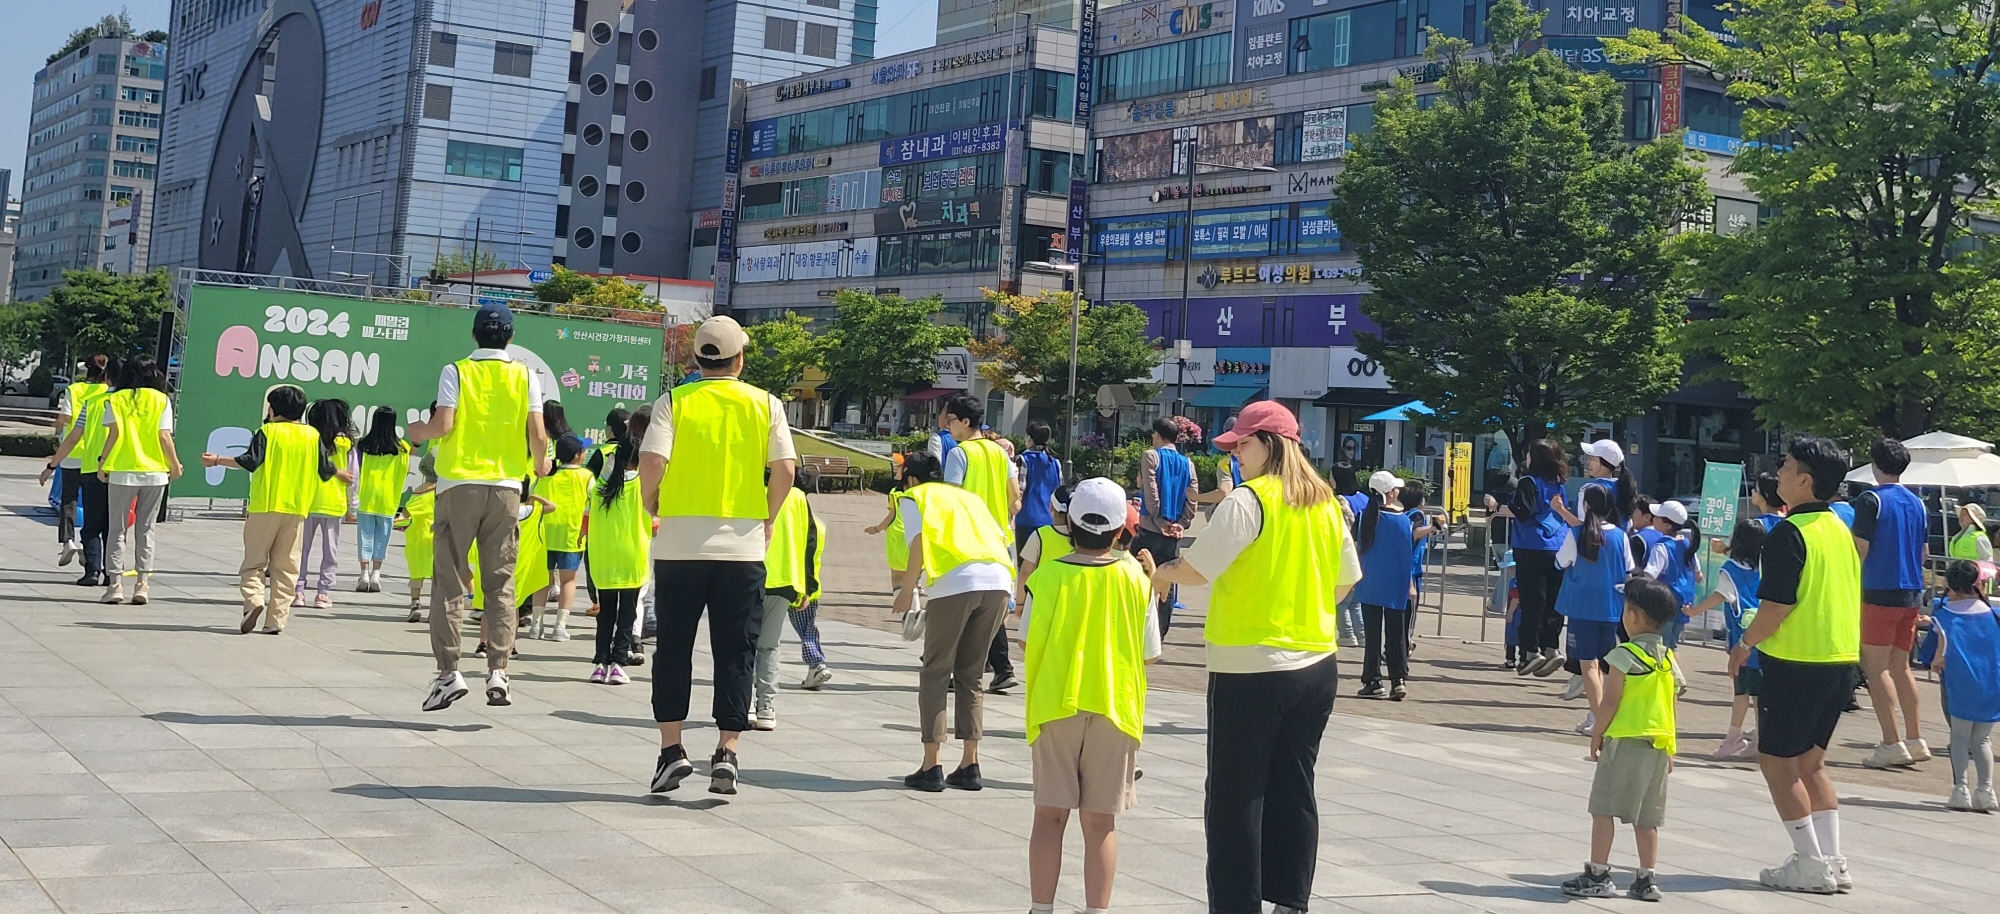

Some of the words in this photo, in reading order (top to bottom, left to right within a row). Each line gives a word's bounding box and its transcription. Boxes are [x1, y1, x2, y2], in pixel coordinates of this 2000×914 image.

[1169, 3, 1212, 35] CMS
[1567, 6, 1635, 23] 치아교정
[1248, 32, 1283, 50] 임플란트
[1246, 52, 1283, 69] 치아교정
[181, 63, 208, 105] NC
[1663, 93, 1678, 123] 마사지
[953, 124, 1002, 145] 이비인후과
[900, 135, 946, 161] 참내과
[963, 140, 1001, 154] 487-8383
[923, 171, 958, 191] 보험공단
[724, 178, 737, 210] 산부인과
[1133, 230, 1154, 246] 성형
[1194, 226, 1211, 243] 보톡스
[1232, 225, 1247, 241] 모발
[1254, 221, 1268, 239] 이식
[823, 250, 838, 266] 치질
[853, 249, 869, 265] 수술
[1220, 264, 1311, 286] 루르드여성의원
[263, 305, 350, 338] 2024
[573, 330, 652, 346] 안산시건강가정지원센터
[215, 325, 380, 387] ANSAN
[618, 363, 649, 381] 가족
[587, 380, 647, 401] 체육대회
[1450, 447, 1469, 459] 통안내
